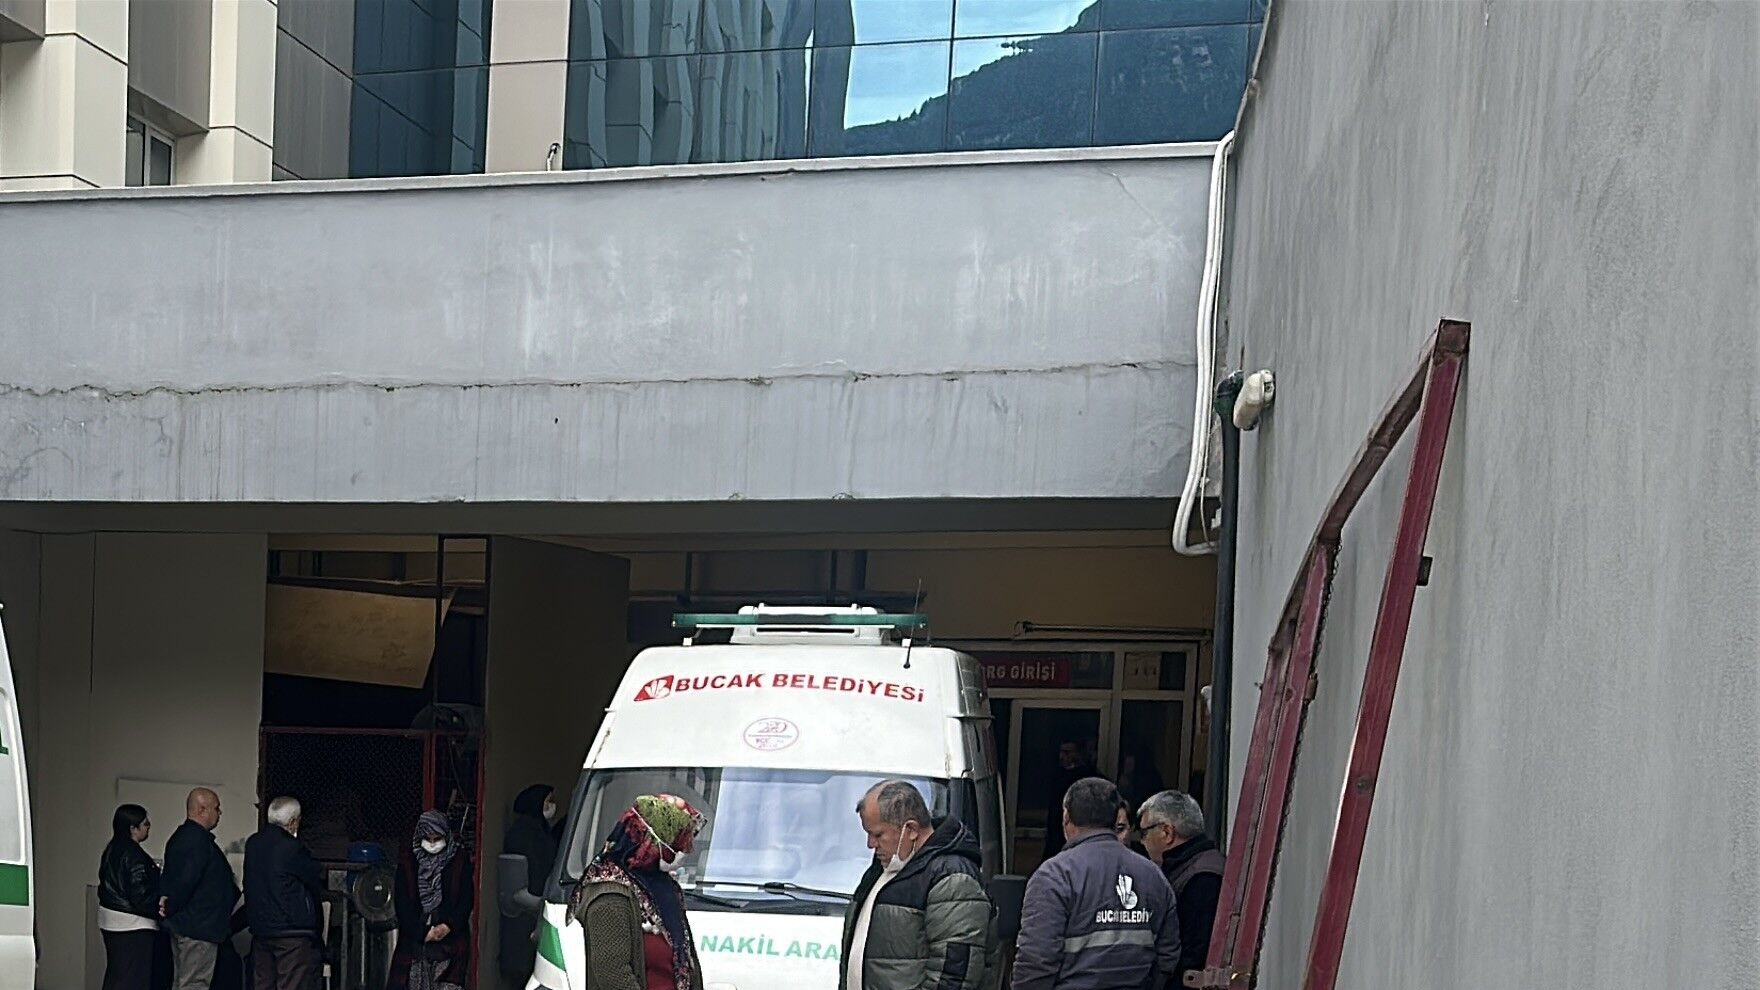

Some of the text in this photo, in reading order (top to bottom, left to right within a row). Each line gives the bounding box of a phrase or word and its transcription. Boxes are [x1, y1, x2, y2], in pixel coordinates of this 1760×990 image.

[675, 673, 766, 692] BUCAK
[700, 934, 840, 961] NAKİL ARA
